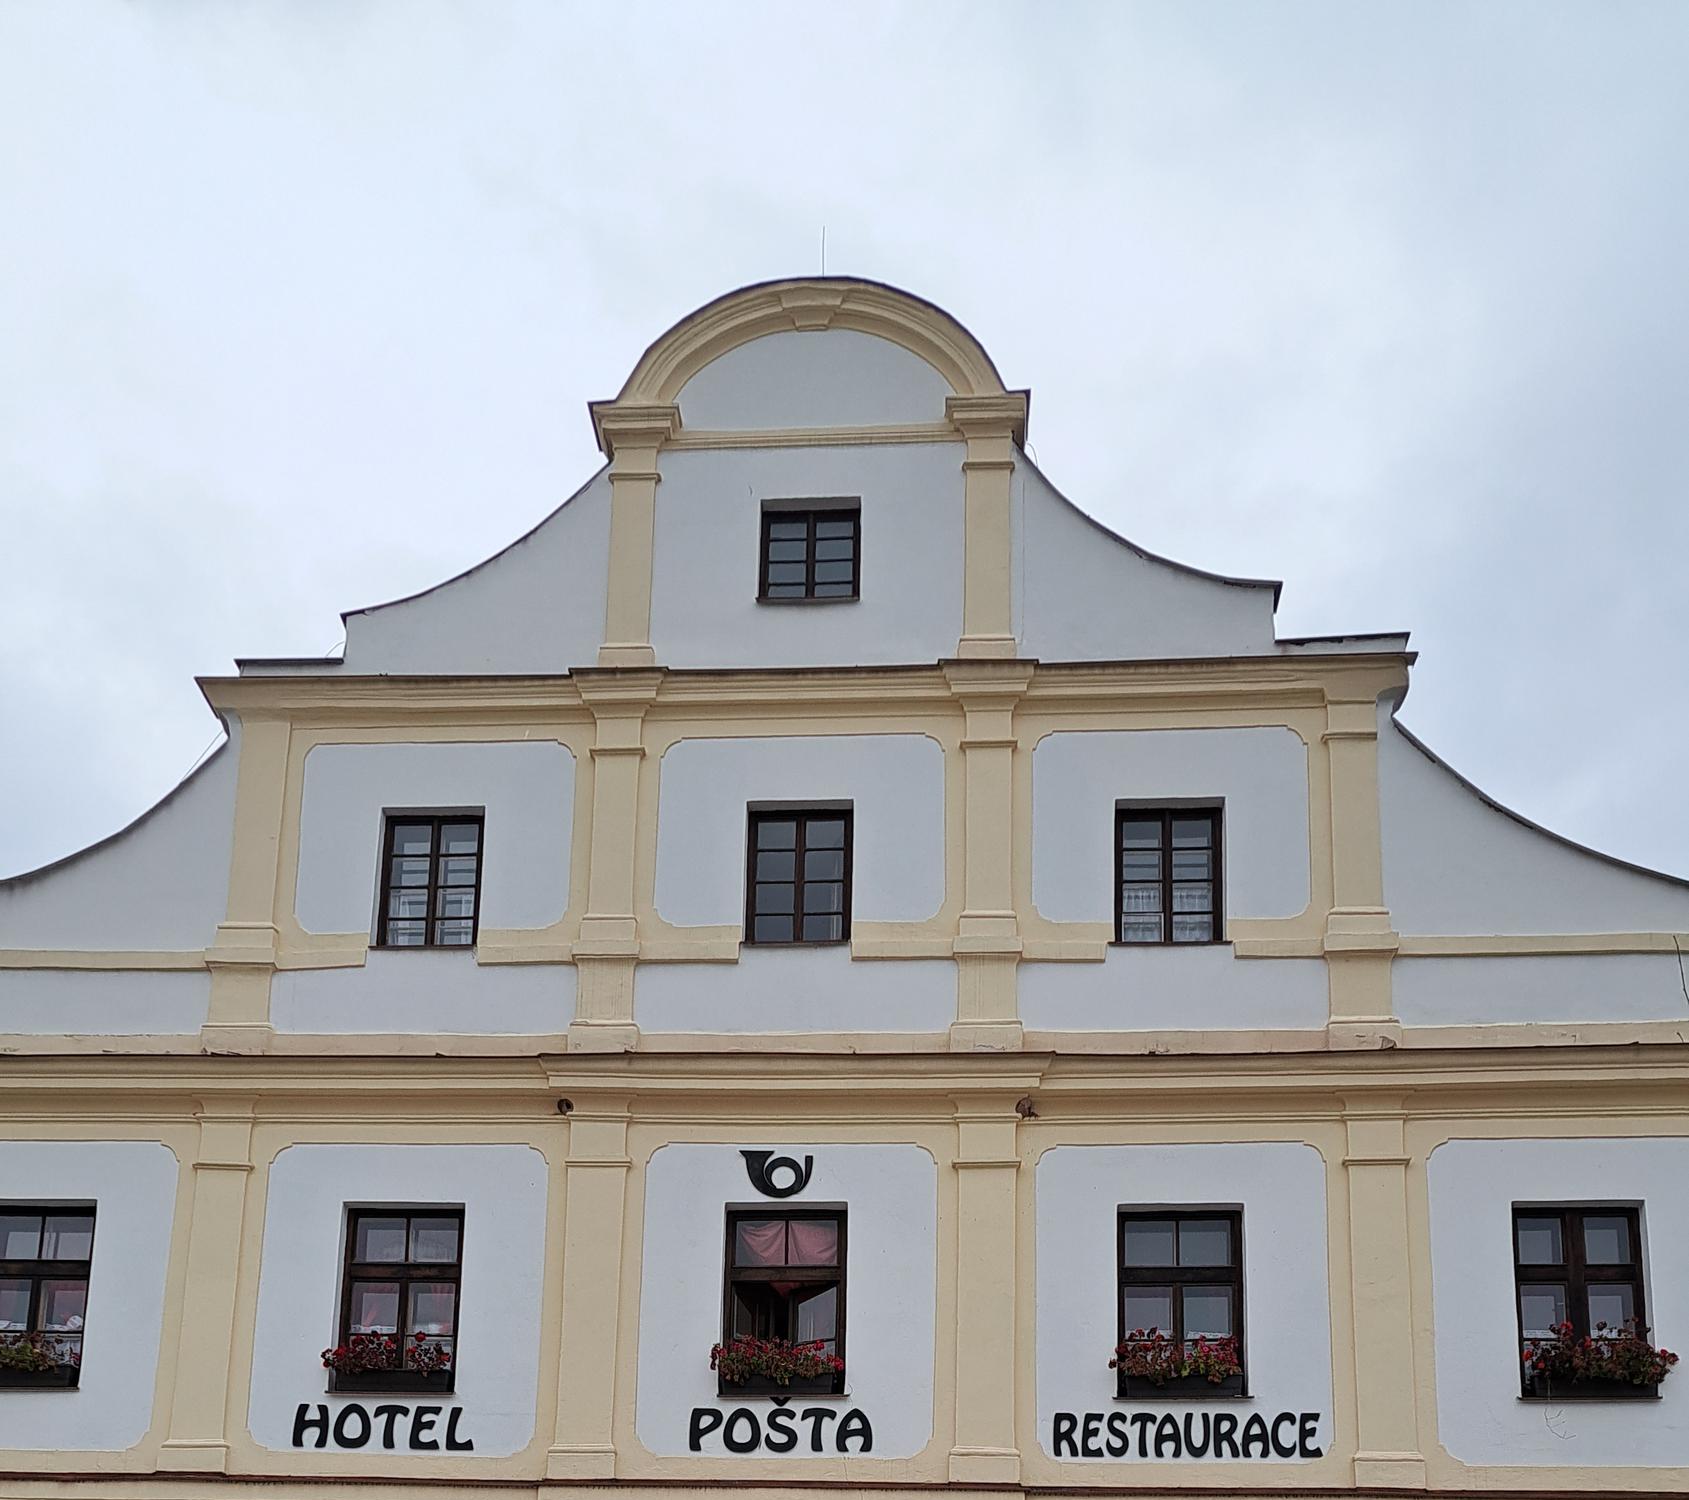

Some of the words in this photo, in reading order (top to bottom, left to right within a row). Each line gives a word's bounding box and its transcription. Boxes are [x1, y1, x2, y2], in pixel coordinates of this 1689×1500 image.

[292, 1403, 474, 1451] HOTEL
[689, 1396, 873, 1454] POŠTA
[1052, 1412, 1324, 1459] RESTAURACE
